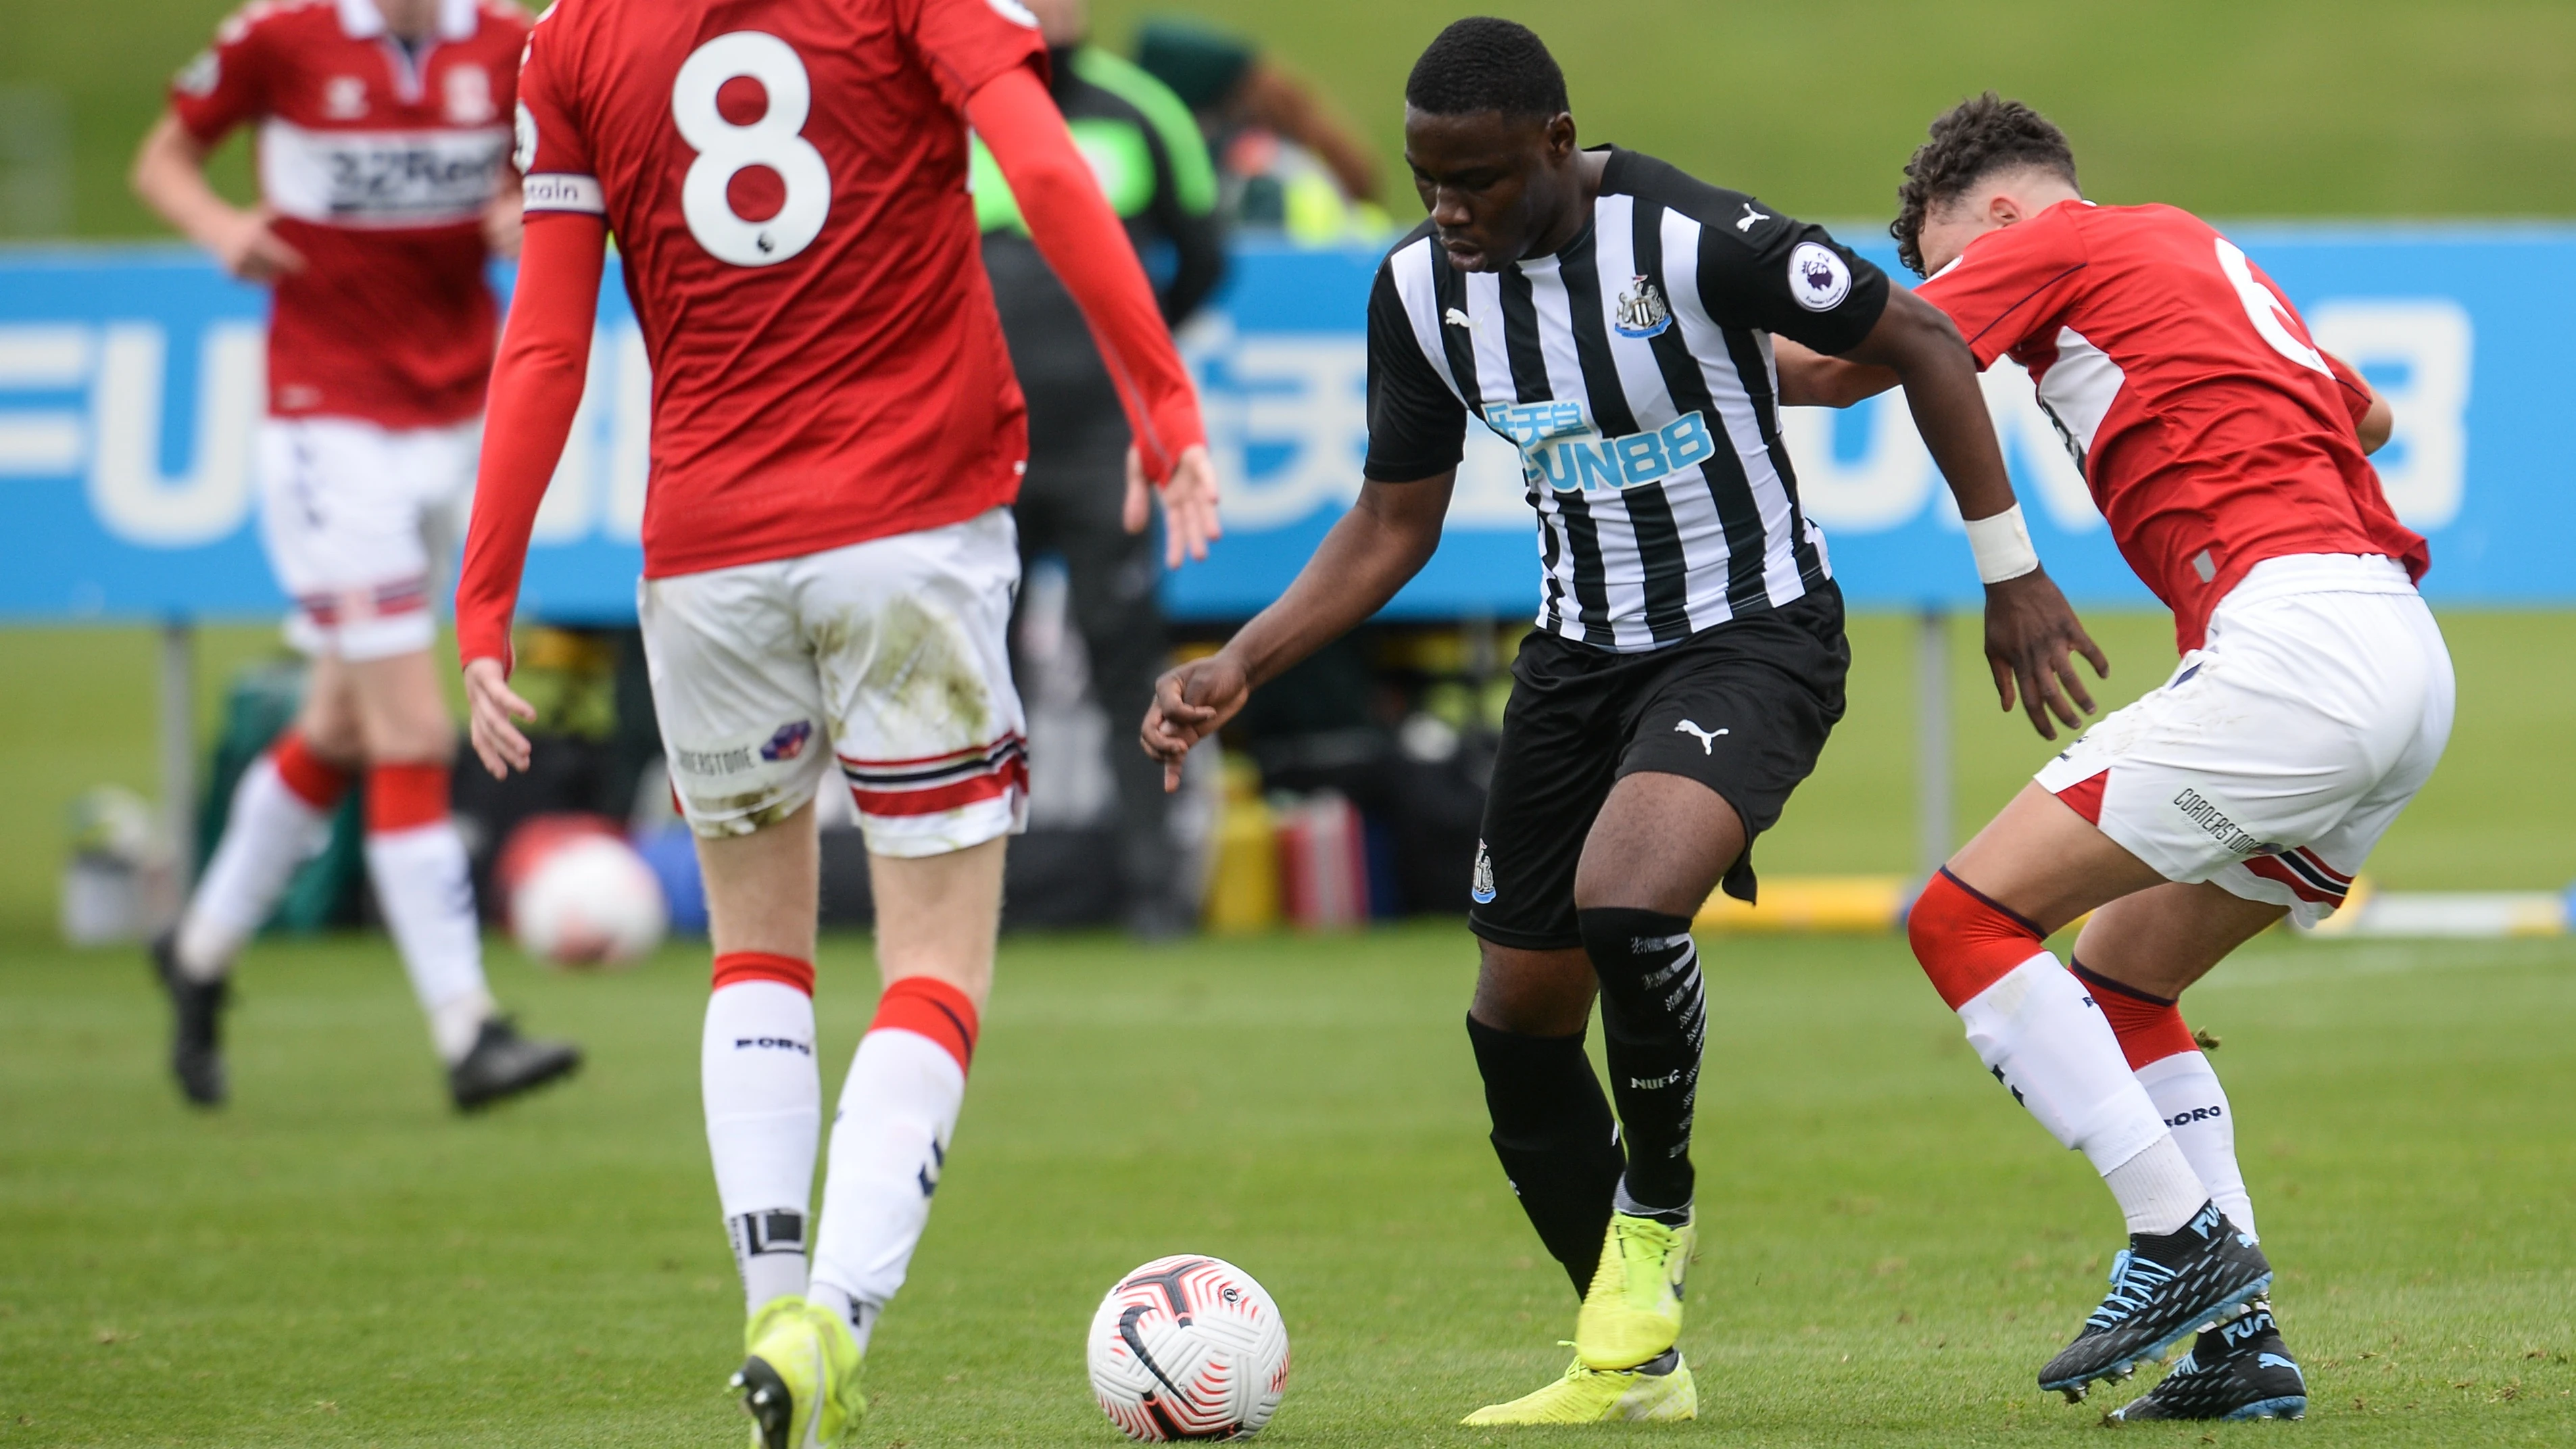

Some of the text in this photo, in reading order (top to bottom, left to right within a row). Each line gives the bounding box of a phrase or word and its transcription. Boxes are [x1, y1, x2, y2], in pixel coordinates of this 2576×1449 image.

[527, 177, 578, 201] tain
[672, 30, 831, 267] 8
[2214, 237, 2337, 380] 6
